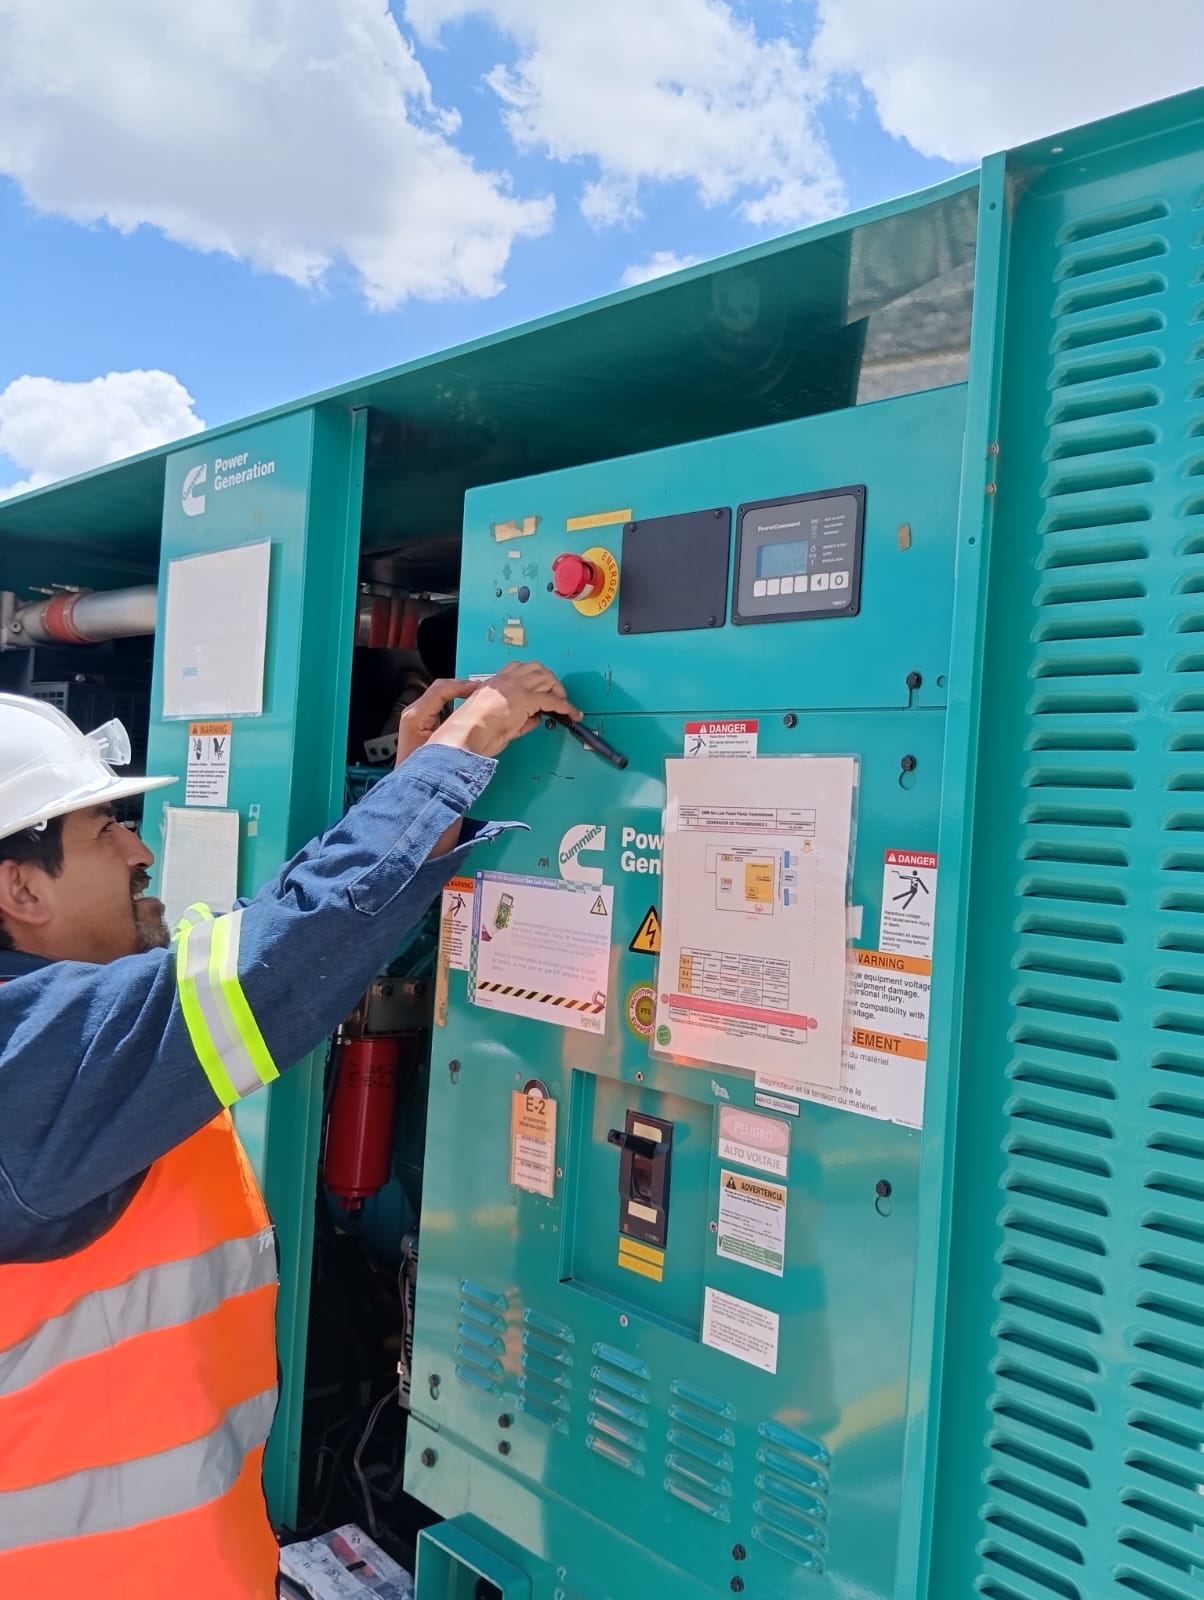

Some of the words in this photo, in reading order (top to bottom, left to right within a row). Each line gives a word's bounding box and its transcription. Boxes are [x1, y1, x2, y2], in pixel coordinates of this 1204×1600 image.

[214, 452, 248, 474] Power
[214, 461, 275, 491] Generation
[757, 521, 801, 532] PowerCommand
[599, 551, 617, 610] EMERGENCY
[709, 723, 746, 734] DANGER
[560, 826, 602, 864] Cummins
[622, 827, 662, 851] Pow
[621, 851, 661, 875] Gen
[898, 854, 936, 866] DANGER
[852, 980, 887, 993] quipment
[887, 986, 920, 999] damage.
[863, 974, 902, 986] equipment
[881, 990, 905, 1004] injury.
[859, 1001, 907, 1018] compatibility
[908, 1010, 925, 1019] with
[849, 1051, 858, 1060] du
[759, 1076, 795, 1092] disjoncteur
[795, 1085, 803, 1094] et
[803, 1087, 810, 1097] la
[811, 1089, 837, 1104] tension
[837, 1095, 847, 1105] du
[855, 1087, 863, 1097] le
[525, 1096, 546, 1115] E-2
[734, 1119, 774, 1139] PELIGRO
[724, 1145, 745, 1159] ALTO
[746, 1150, 781, 1170] VOLTAJE
[741, 1182, 783, 1201] ADVERTENCIA
